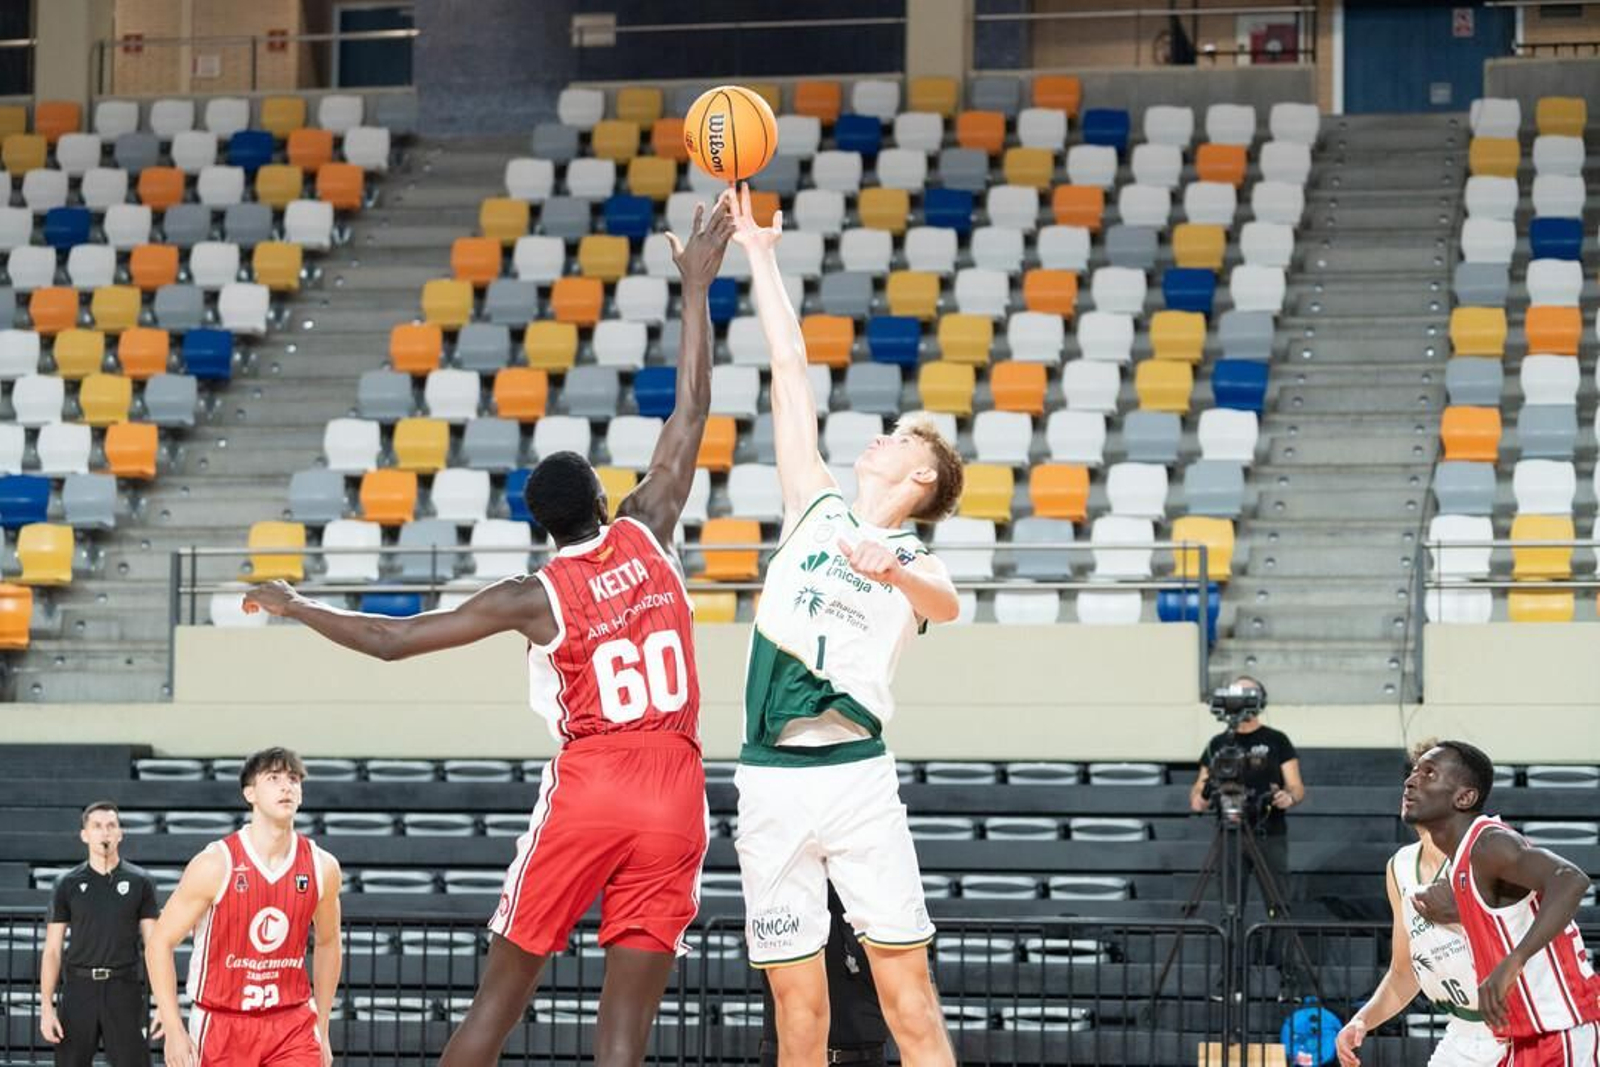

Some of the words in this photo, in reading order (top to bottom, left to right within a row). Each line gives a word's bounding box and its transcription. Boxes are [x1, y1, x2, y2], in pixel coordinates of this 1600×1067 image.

[708, 114, 725, 172] Wilson
[588, 557, 649, 602] KEITA
[587, 622, 610, 640] AIR
[817, 635, 826, 670] 1
[592, 630, 687, 723] 60
[242, 984, 279, 1011] 22
[1441, 979, 1470, 1005] 16
